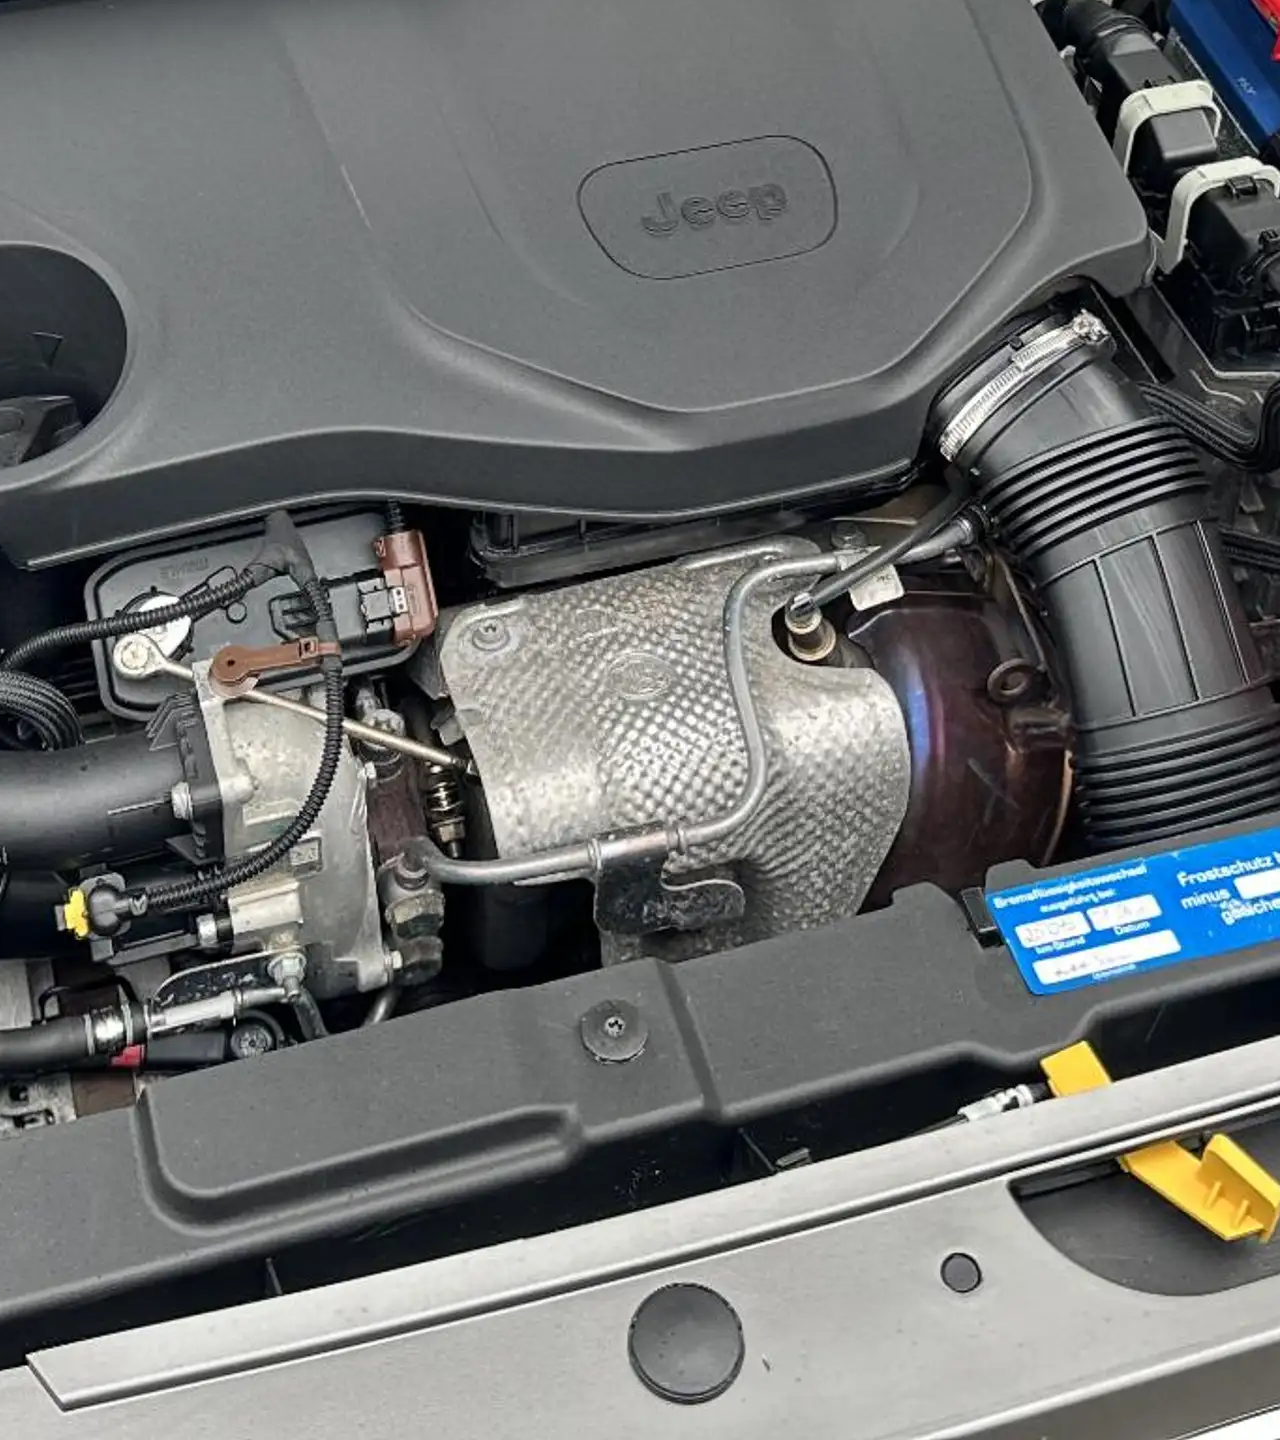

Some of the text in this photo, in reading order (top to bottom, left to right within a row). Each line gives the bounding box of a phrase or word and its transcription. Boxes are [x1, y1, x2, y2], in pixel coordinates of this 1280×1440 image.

[641, 183, 787, 237] Jeep
[1177, 855, 1274, 887] Frostschutz
[1180, 888, 1231, 909] minus
[1114, 921, 1151, 935] Datum
